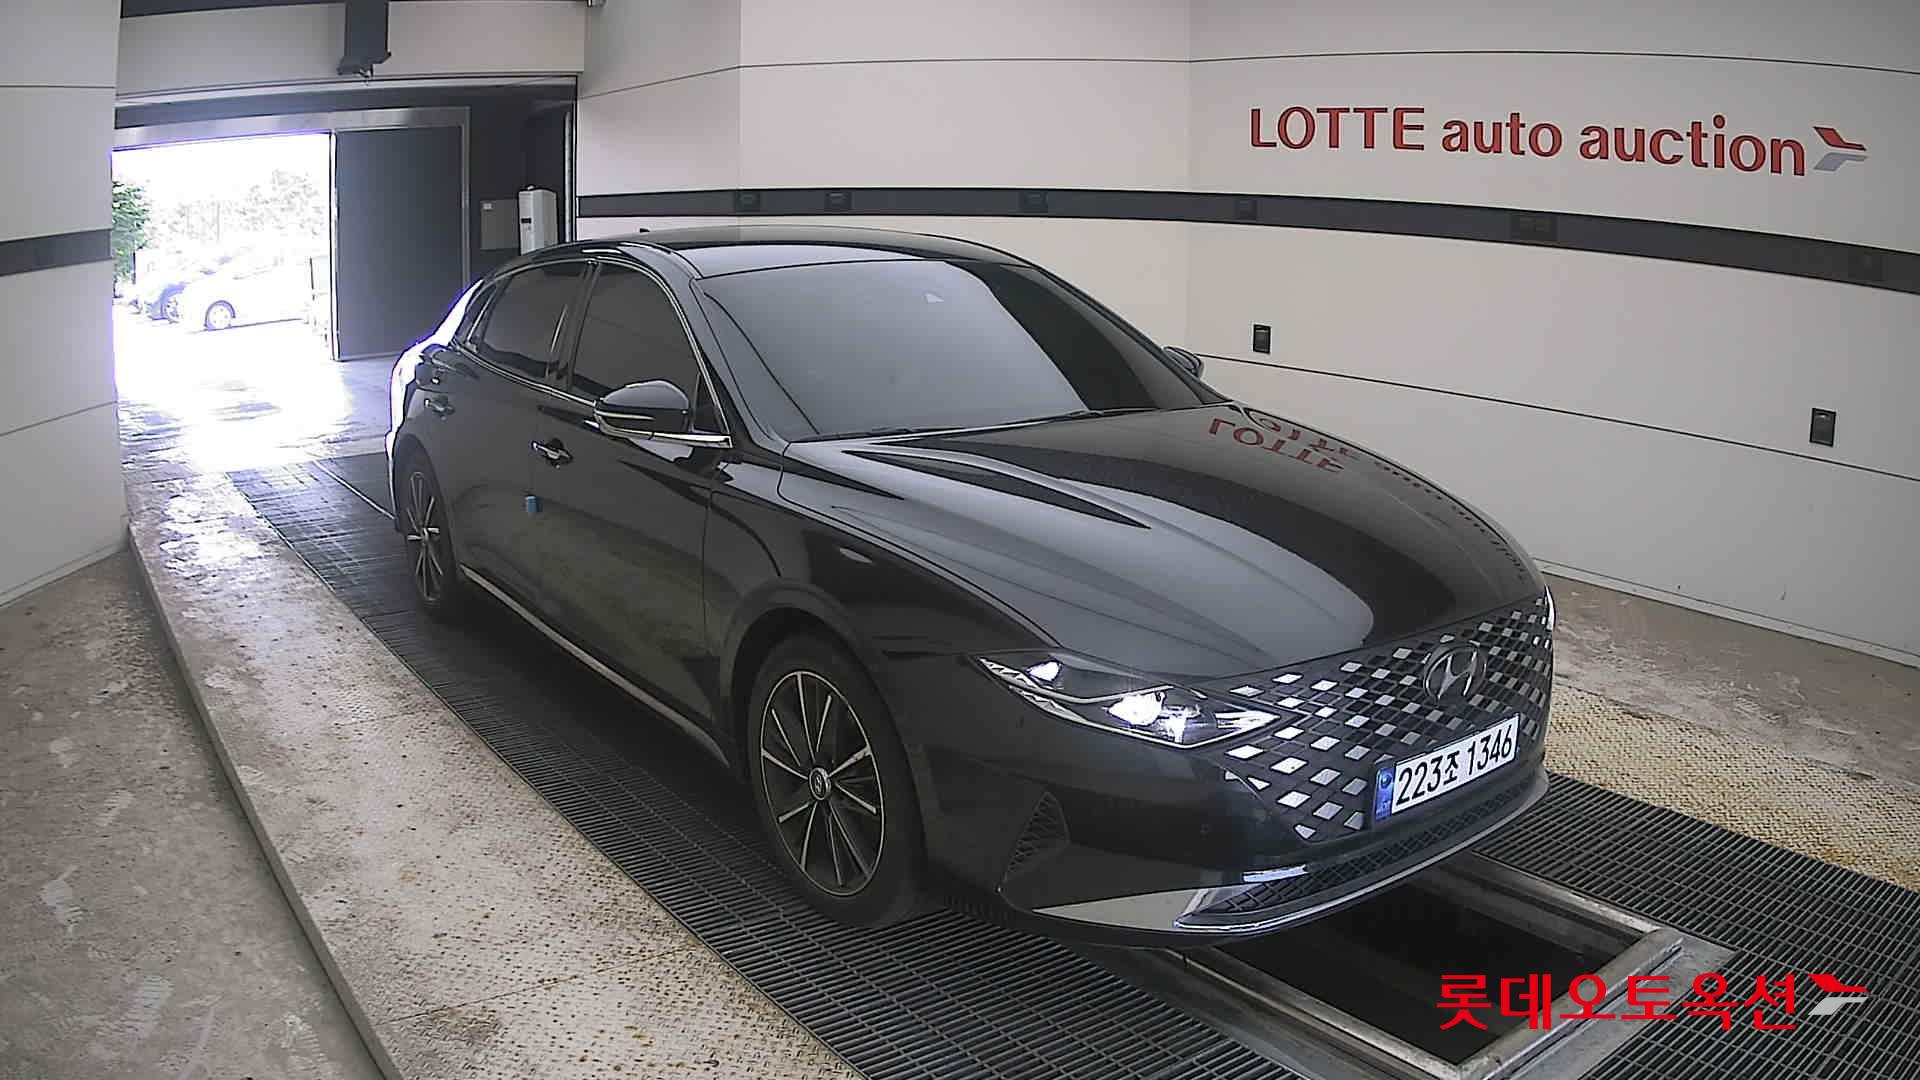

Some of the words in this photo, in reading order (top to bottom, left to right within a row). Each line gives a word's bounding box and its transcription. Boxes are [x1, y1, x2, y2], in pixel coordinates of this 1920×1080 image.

[1250, 106, 1425, 151] LOTTE
[1442, 112, 1562, 157] auto
[1579, 115, 1806, 177] auction
[1396, 750, 1460, 806] 223조
[1468, 724, 1513, 776] 1346
